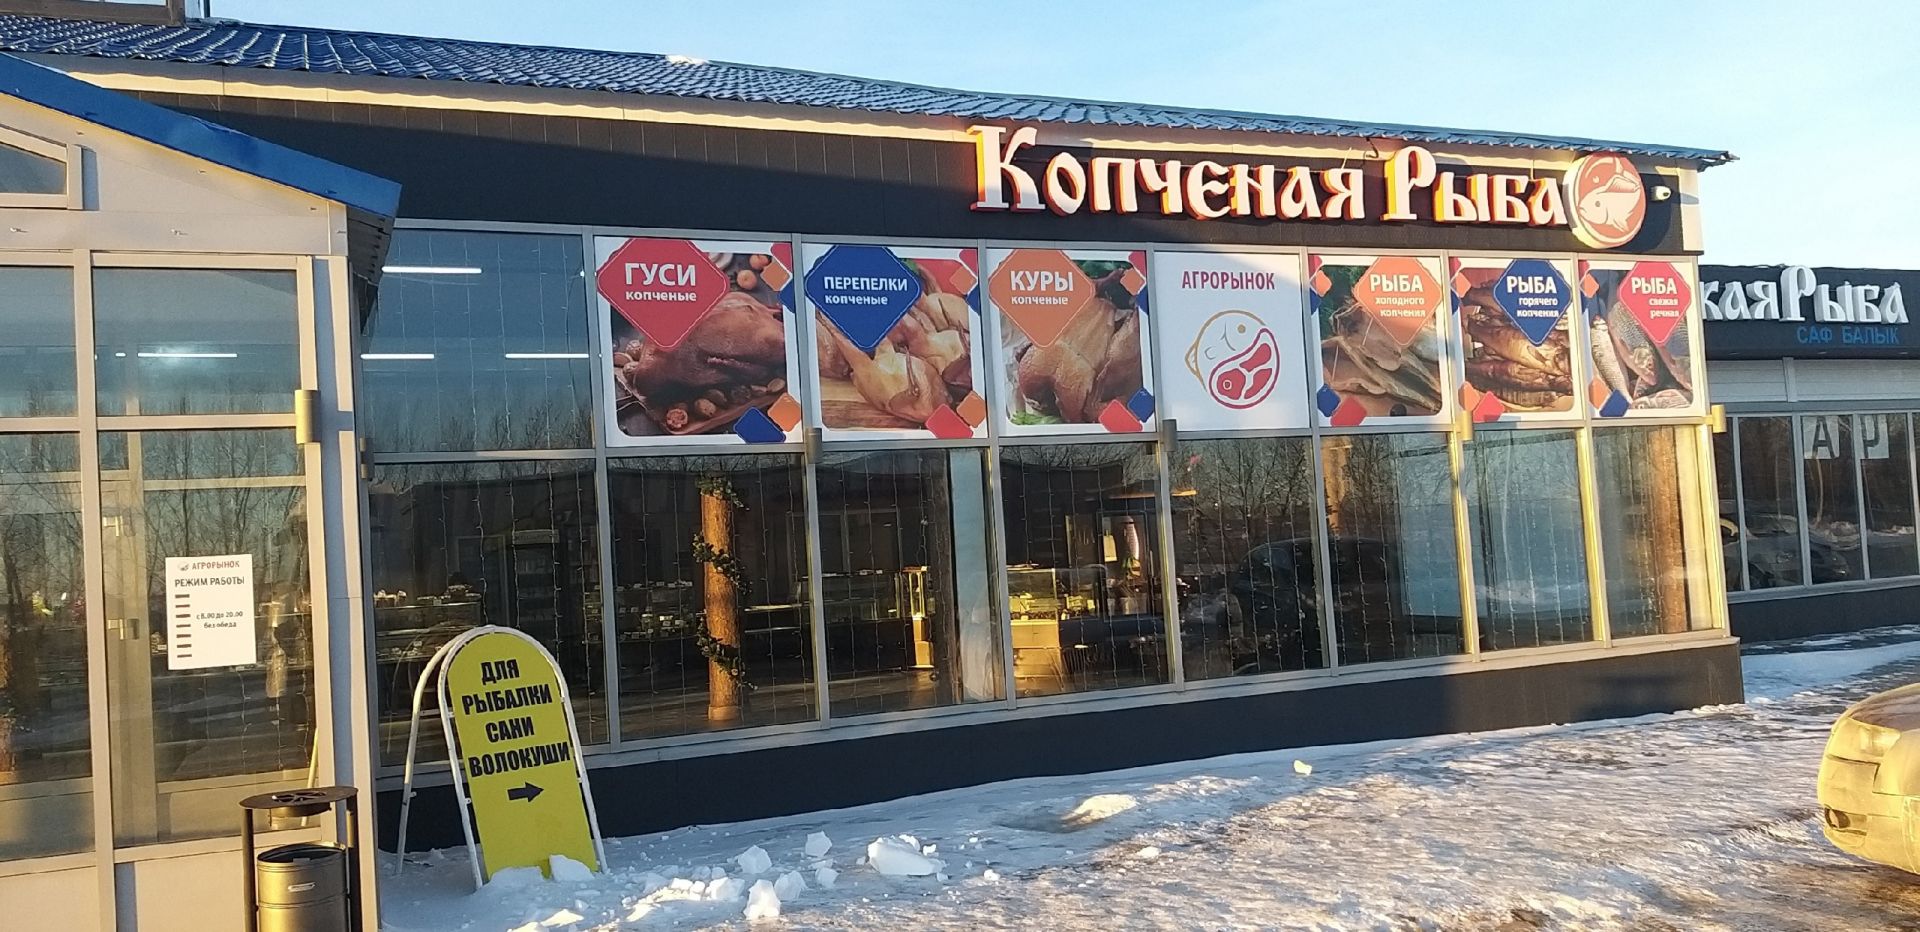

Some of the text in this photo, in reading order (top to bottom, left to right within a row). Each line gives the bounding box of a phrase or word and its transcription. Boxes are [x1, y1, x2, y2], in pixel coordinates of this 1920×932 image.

[624, 262, 697, 287] ГУСИ
[1010, 270, 1074, 292] КУРЫ
[1181, 270, 1275, 290] АГРОРЫНОК
[823, 275, 908, 292] ПЕРЕПЕЛКИ
[1369, 274, 1424, 293] РЫБА
[1506, 275, 1557, 295] РЫБА
[1631, 276, 1677, 296] РЫБА
[625, 290, 698, 302] копченые
[824, 293, 888, 306] копченые
[1011, 295, 1069, 306] копченые
[1375, 297, 1425, 307] холодного
[1518, 297, 1559, 308] горячего
[1648, 297, 1679, 307] свежая
[1380, 308, 1426, 319] копчения
[1516, 309, 1560, 319] копчения
[1649, 309, 1680, 320] речная
[1796, 326, 1900, 345] САФ БАЛЫК
[192, 560, 240, 570] АГРОРЫНОК
[174, 576, 245, 587] РЕЖИМ РАБОТЫ
[216, 621, 237, 629] обеда
[481, 659, 520, 685] ДЛЯ
[461, 684, 552, 715] РЫБАЛКИ
[485, 717, 535, 743] САНИ
[468, 742, 571, 778] ВОЛОКУШИ
